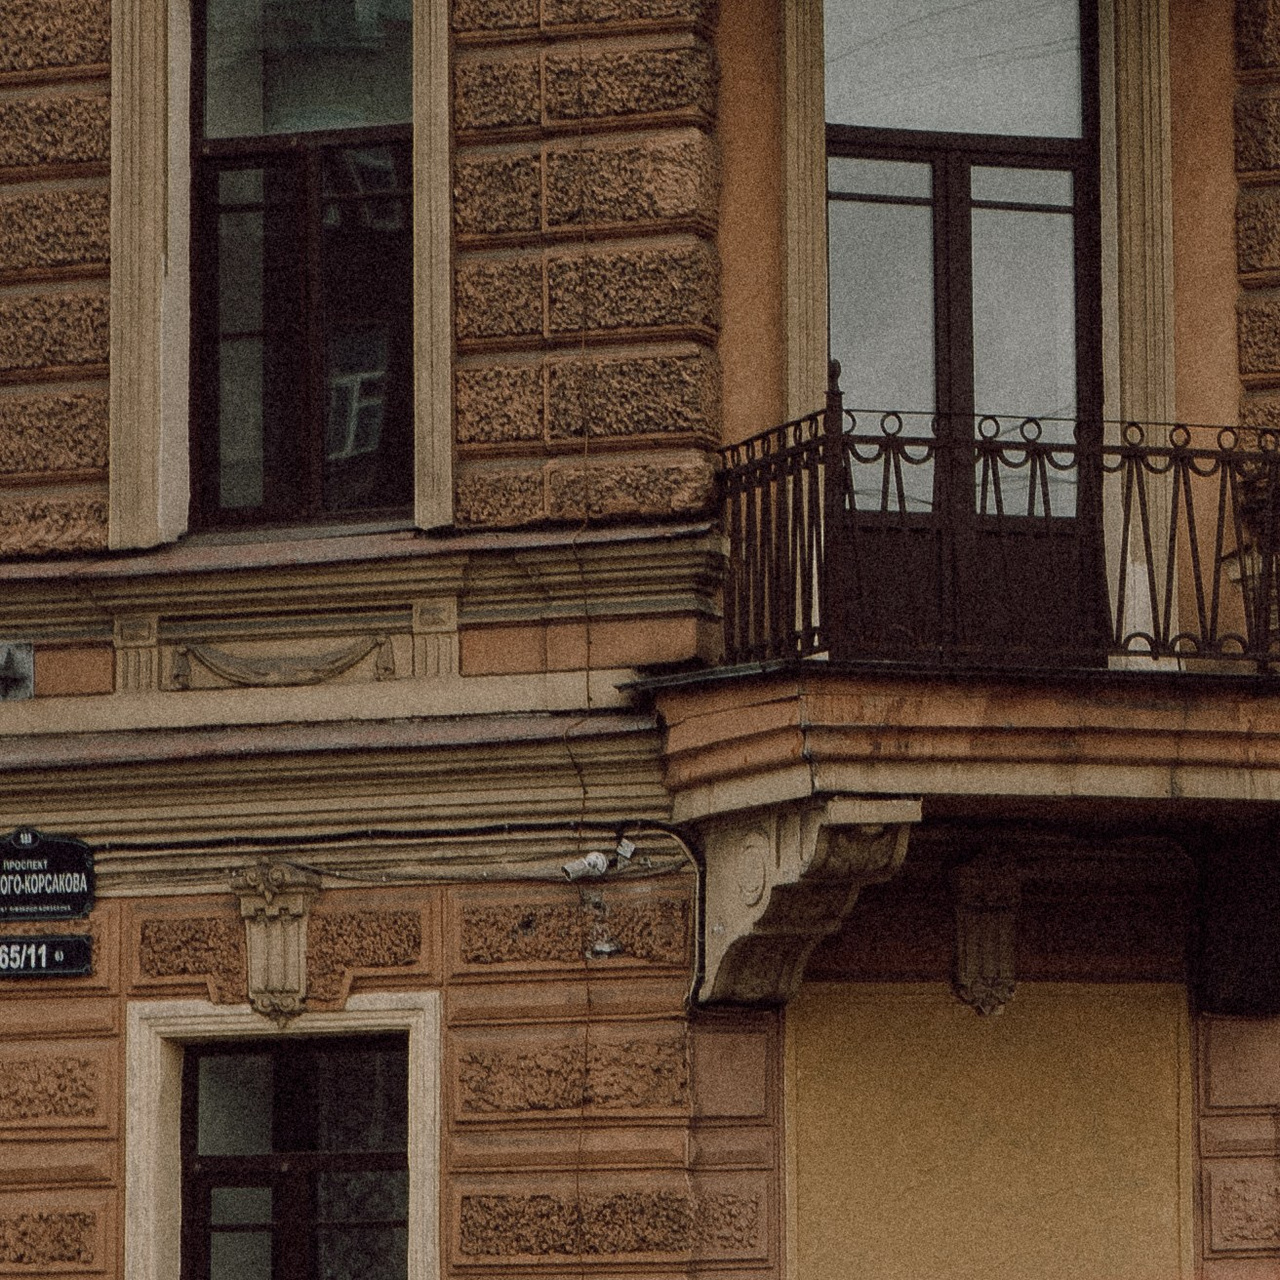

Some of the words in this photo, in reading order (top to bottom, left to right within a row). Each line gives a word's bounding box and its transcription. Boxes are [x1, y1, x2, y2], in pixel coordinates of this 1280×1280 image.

[3, 860, 48, 870] ПРОСПЕКТ
[0, 873, 88, 895] ОГО-КОРСАКОВА
[0, 943, 47, 969] 65/11
